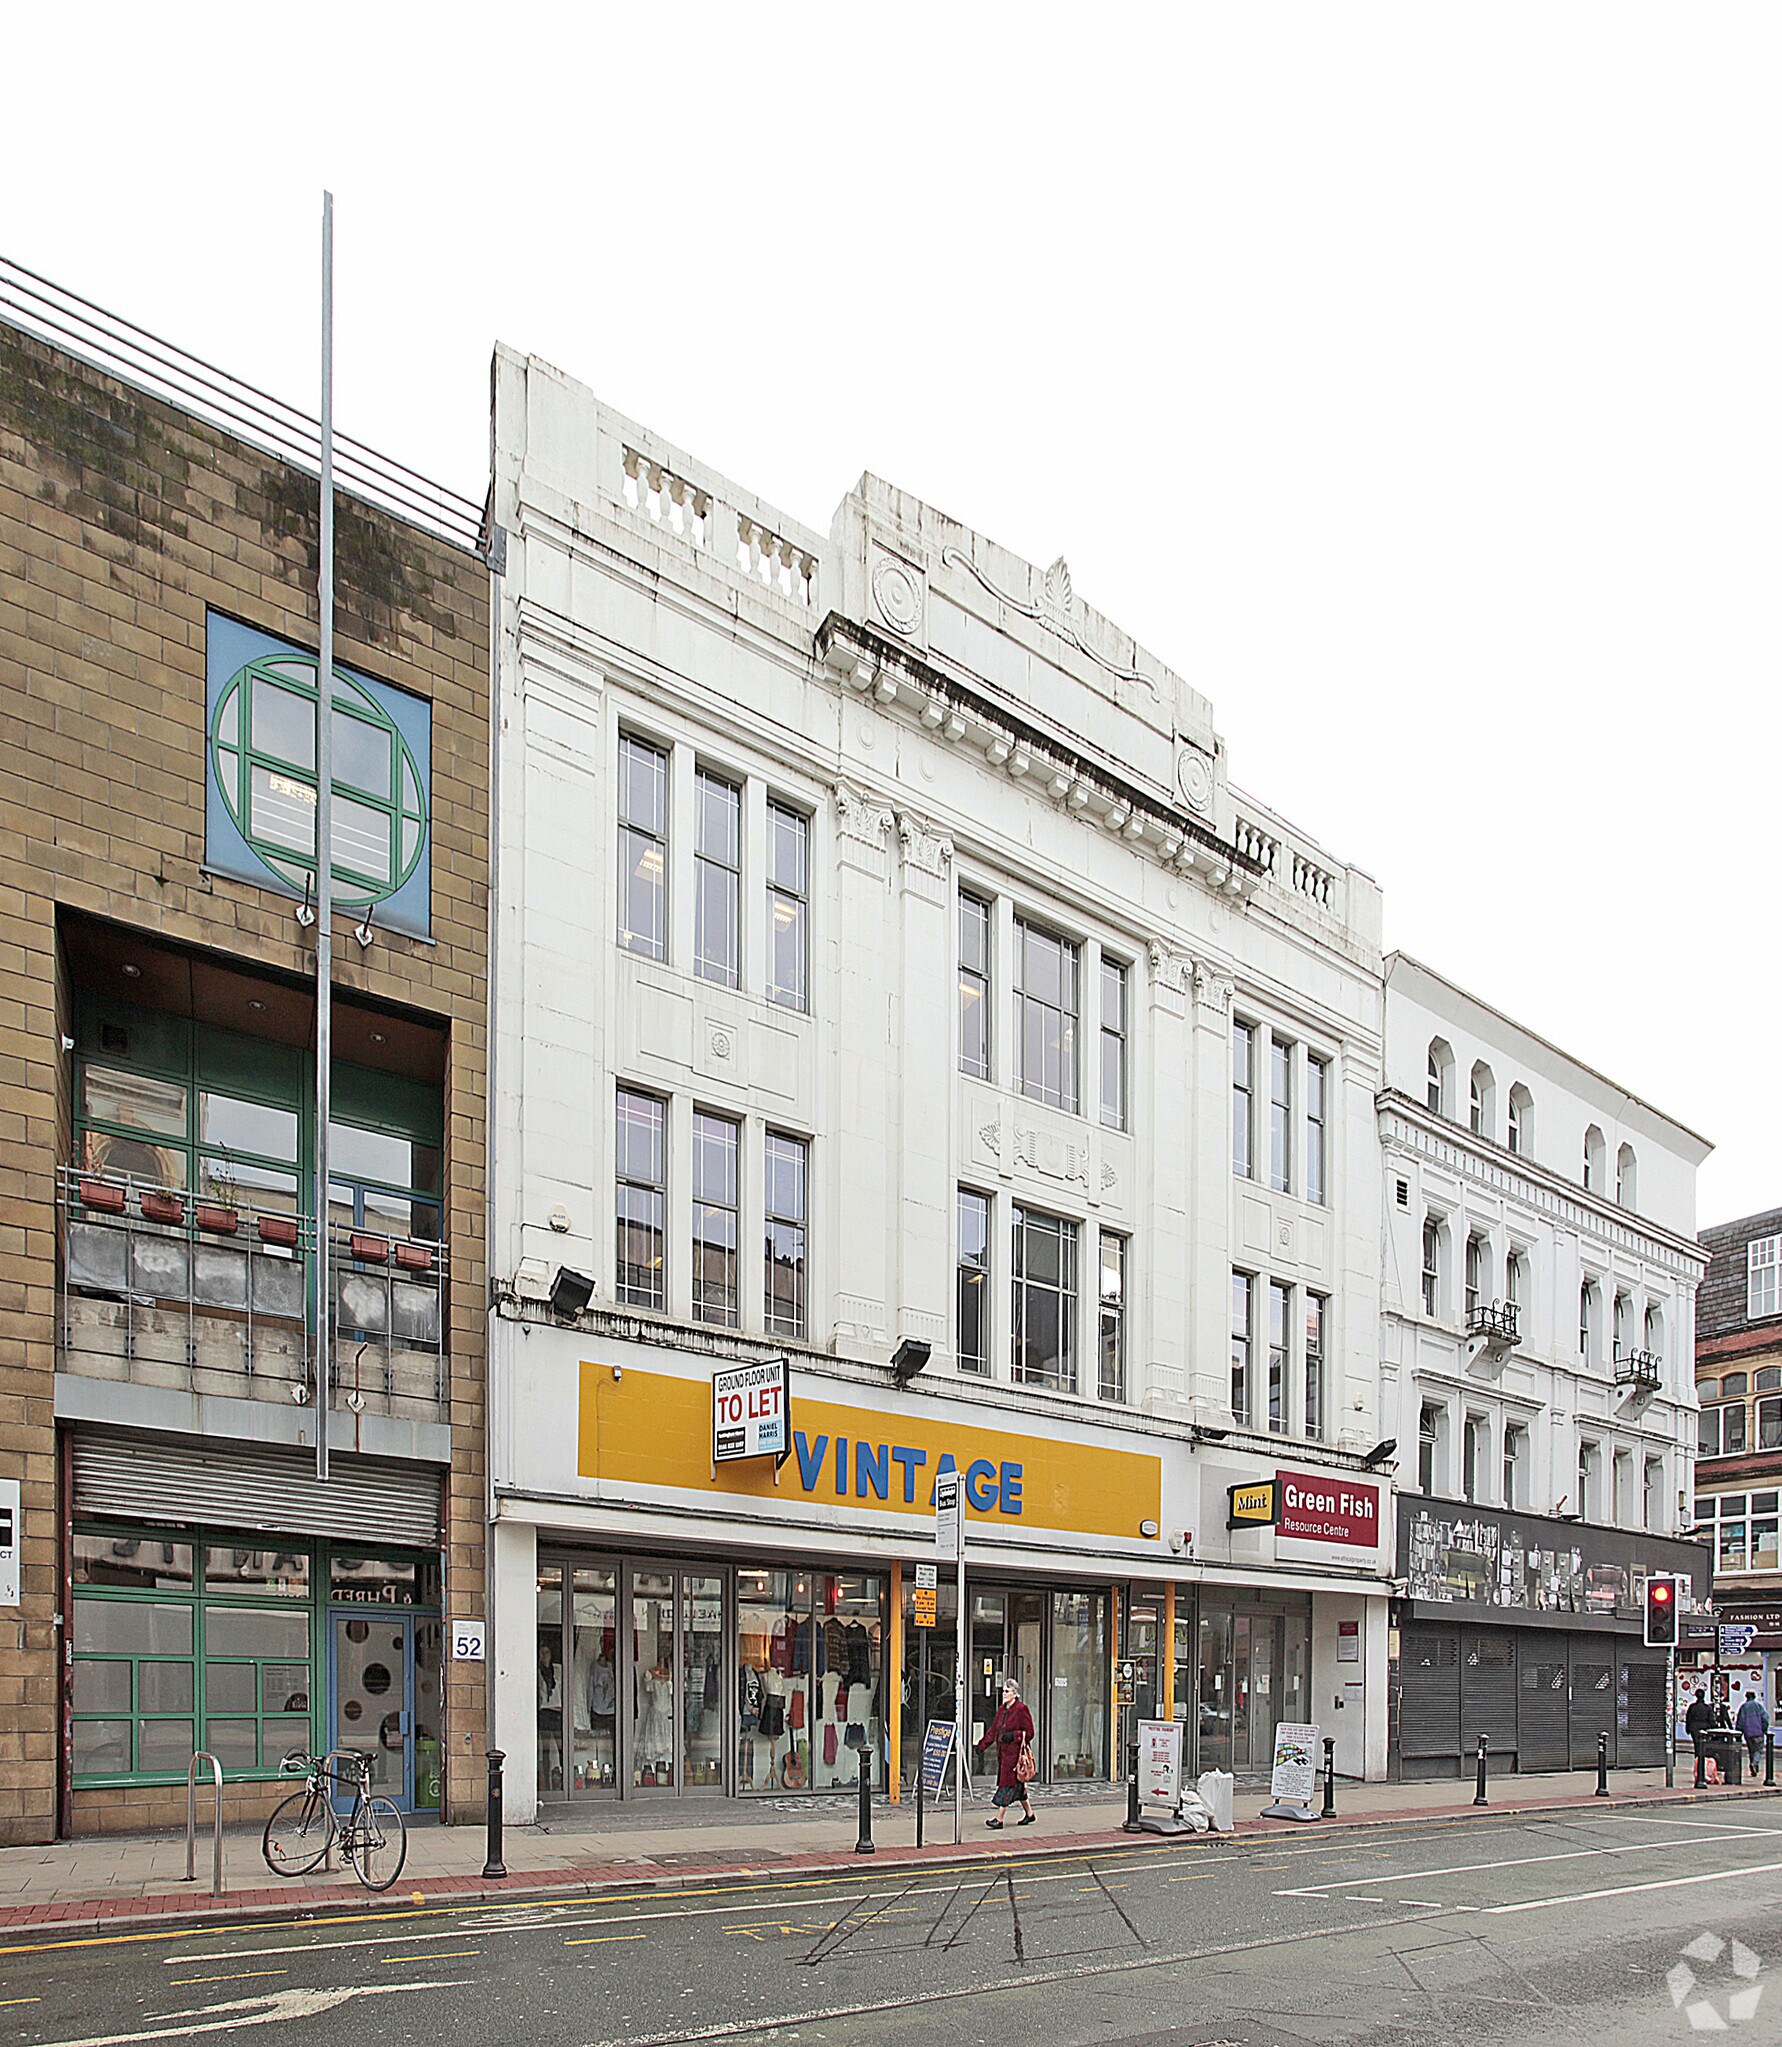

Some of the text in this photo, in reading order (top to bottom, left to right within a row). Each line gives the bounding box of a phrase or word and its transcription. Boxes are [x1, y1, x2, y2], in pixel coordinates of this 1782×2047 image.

[718, 1365, 780, 1392] GROUND FLOOR UNIT
[718, 1385, 782, 1424] TO LET
[759, 1423, 778, 1432] DANIEL
[759, 1430, 778, 1440] HARRIS
[946, 1498, 956, 1507] Stop
[1237, 1493, 1268, 1511] Mint
[1285, 1484, 1373, 1519] Green Fish
[1284, 1517, 1349, 1538] Resource Centre
[456, 1636, 482, 1656] 52
